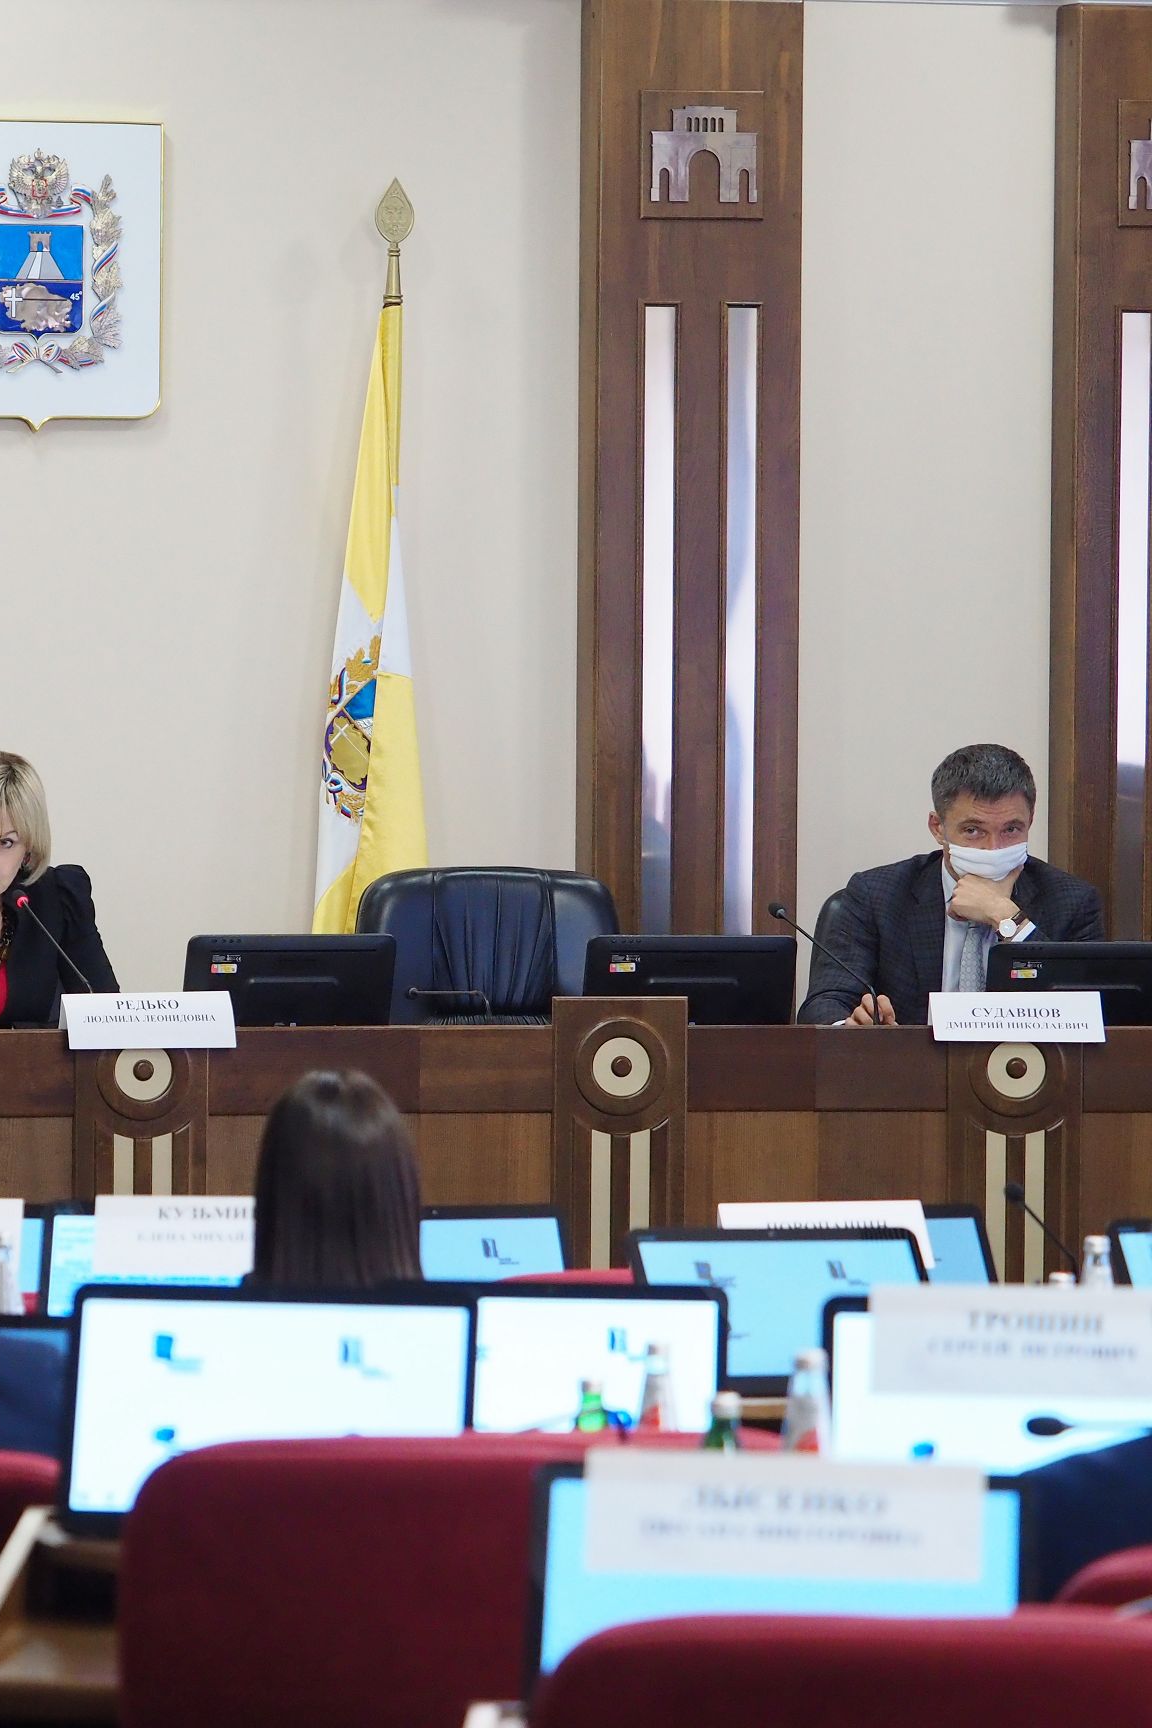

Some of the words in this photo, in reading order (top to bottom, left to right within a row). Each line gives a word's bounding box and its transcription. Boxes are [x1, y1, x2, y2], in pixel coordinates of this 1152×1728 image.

[116, 999, 180, 1010] РЕДЬКО
[83, 1014, 141, 1024] ЛЮДМИЛА
[142, 1013, 217, 1023] ЛЕОНИДОВНА
[971, 1007, 1062, 1019] СУДАВЦОВ
[946, 1021, 1004, 1030] ДМИТРИЙ
[1006, 1021, 1090, 1031] НИКОЛАЕВИЧ
[158, 1206, 248, 1220] КУЗЬМИ
